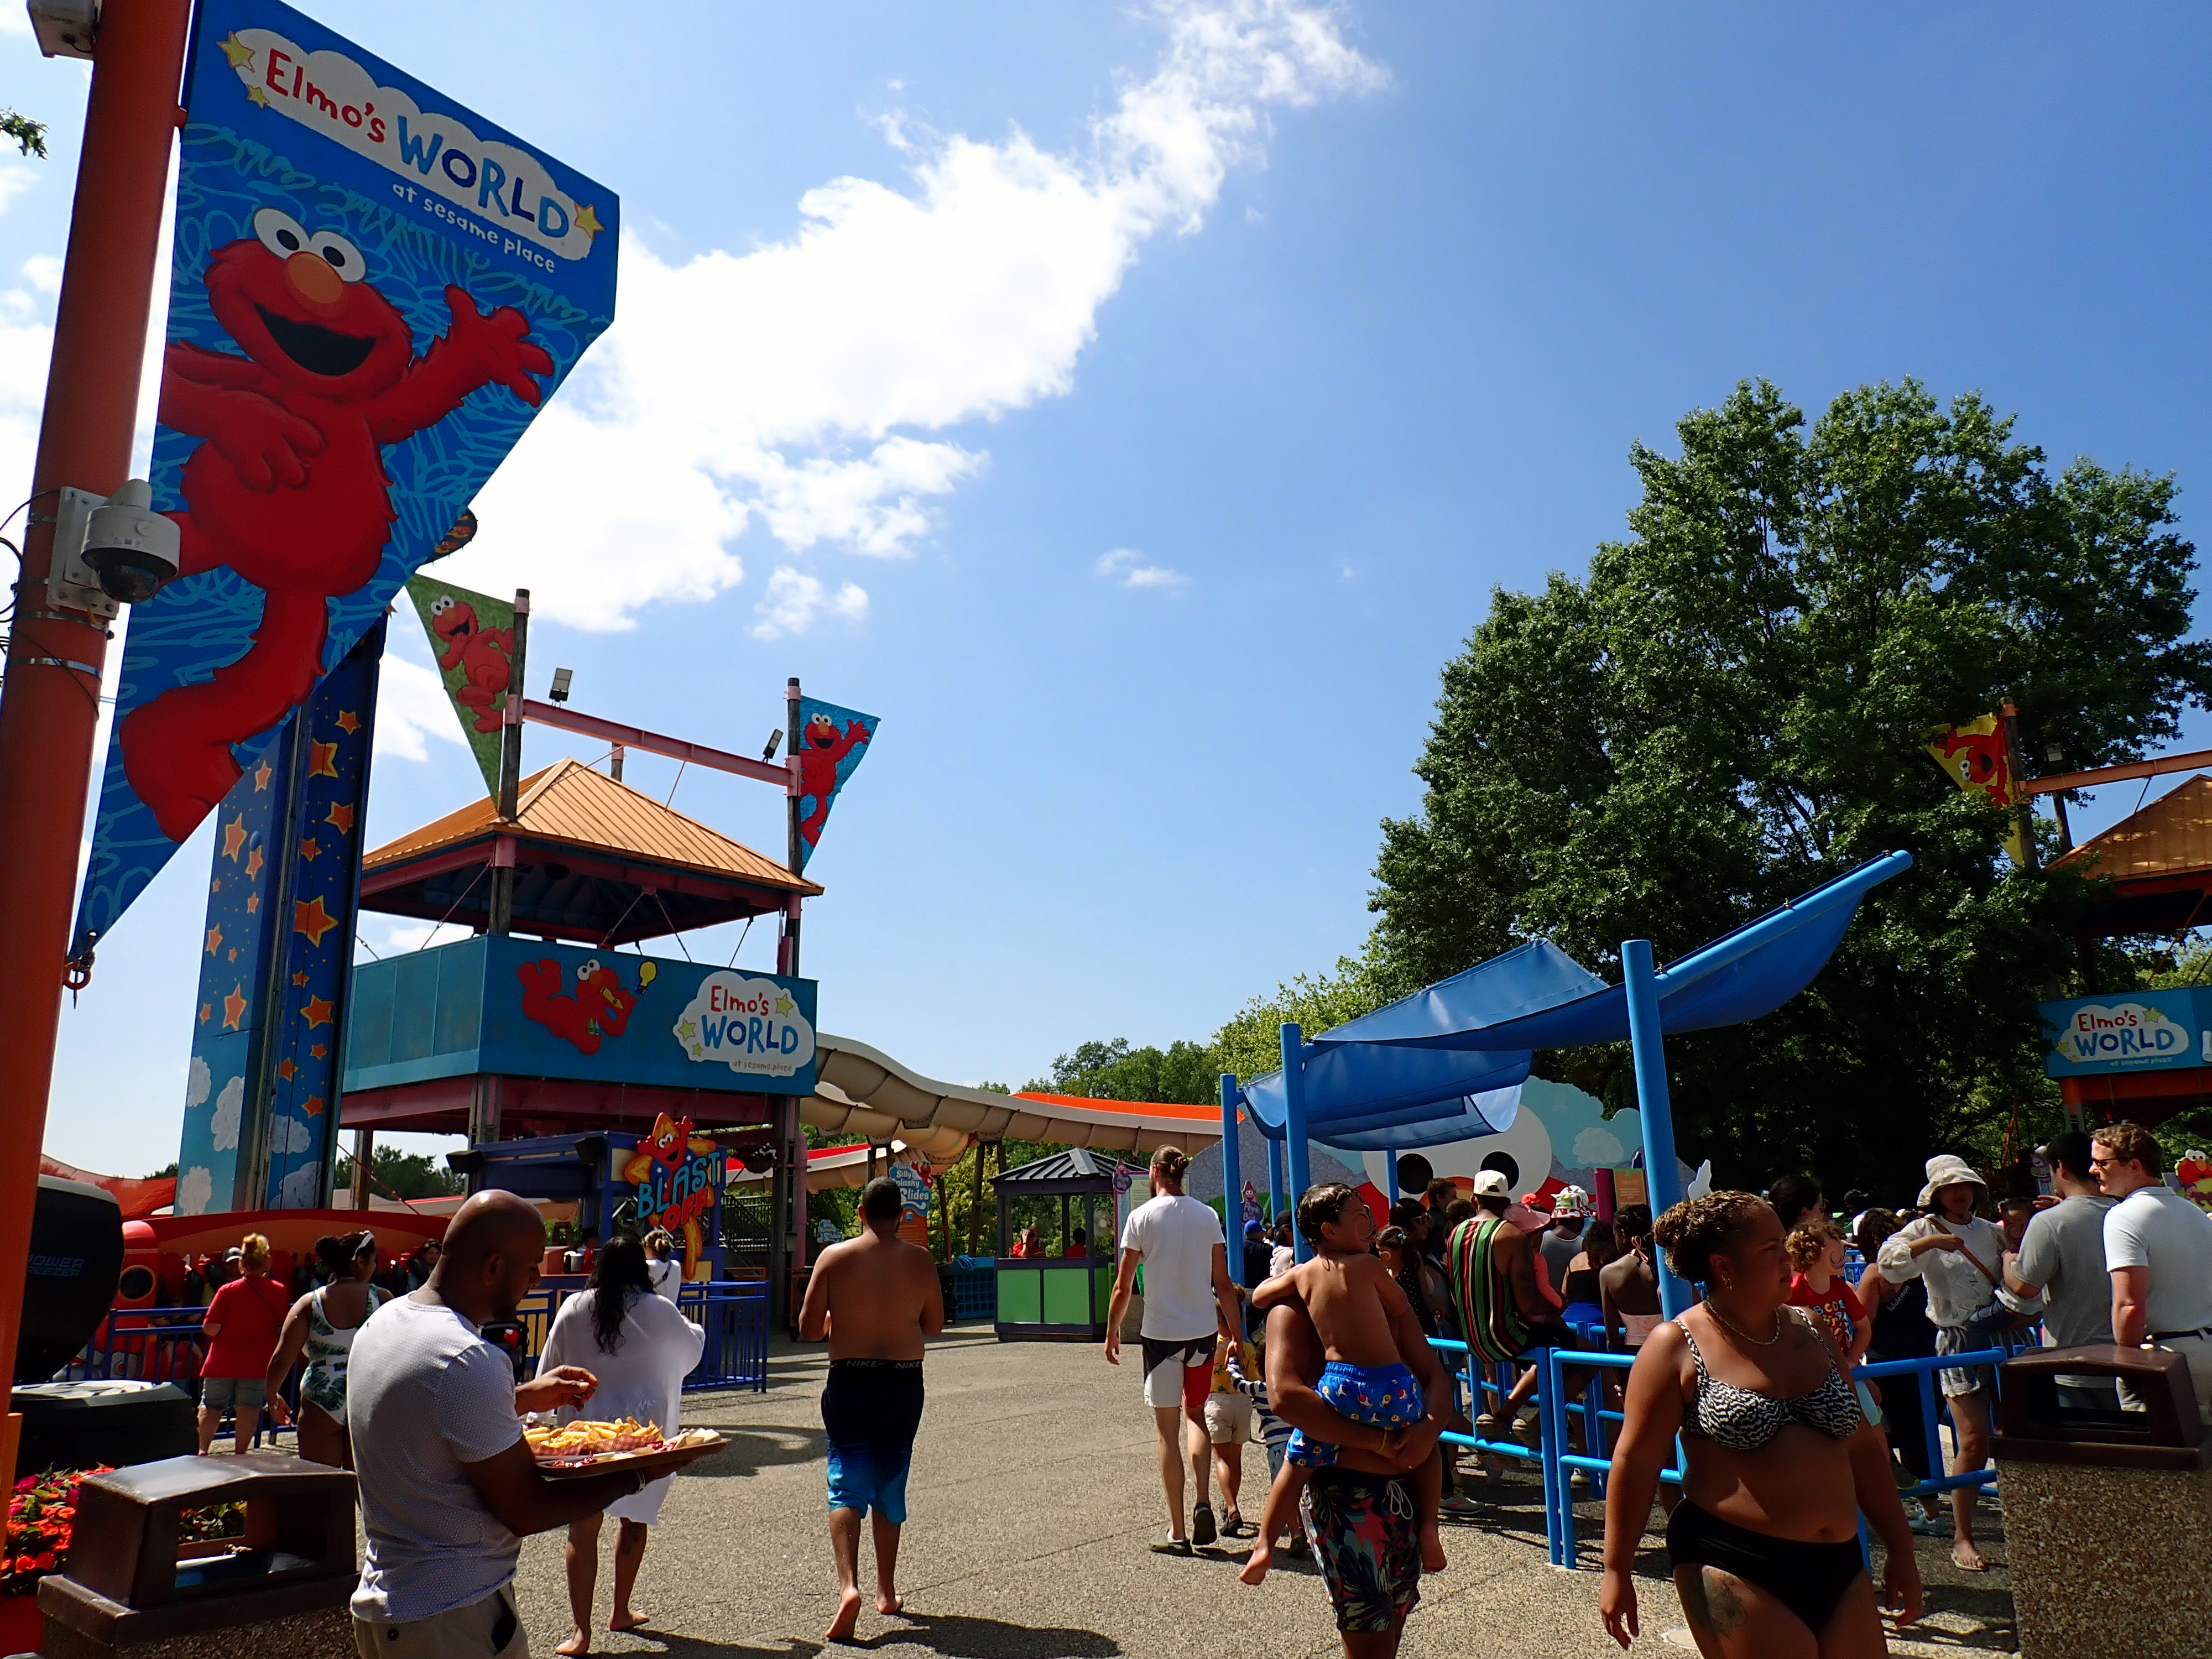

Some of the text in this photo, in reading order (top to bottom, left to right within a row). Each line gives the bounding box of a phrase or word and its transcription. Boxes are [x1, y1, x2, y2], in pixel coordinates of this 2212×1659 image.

[266, 48, 569, 238] Elmo's WORLD
[392, 183, 555, 273] at sesame place
[710, 985, 769, 1016] Elmo's
[701, 1015, 799, 1055] WORLD
[2078, 1010, 2138, 1032] Elmo's
[2074, 1029, 2175, 1056] WORLD
[773, 1063, 792, 1072] place
[638, 1152, 720, 1219] BLAST
[896, 1170, 912, 1179] Silly
[896, 1178, 920, 1188] plashy
[663, 1189, 707, 1231] OFF
[1809, 1299, 1845, 1316] BCDE
